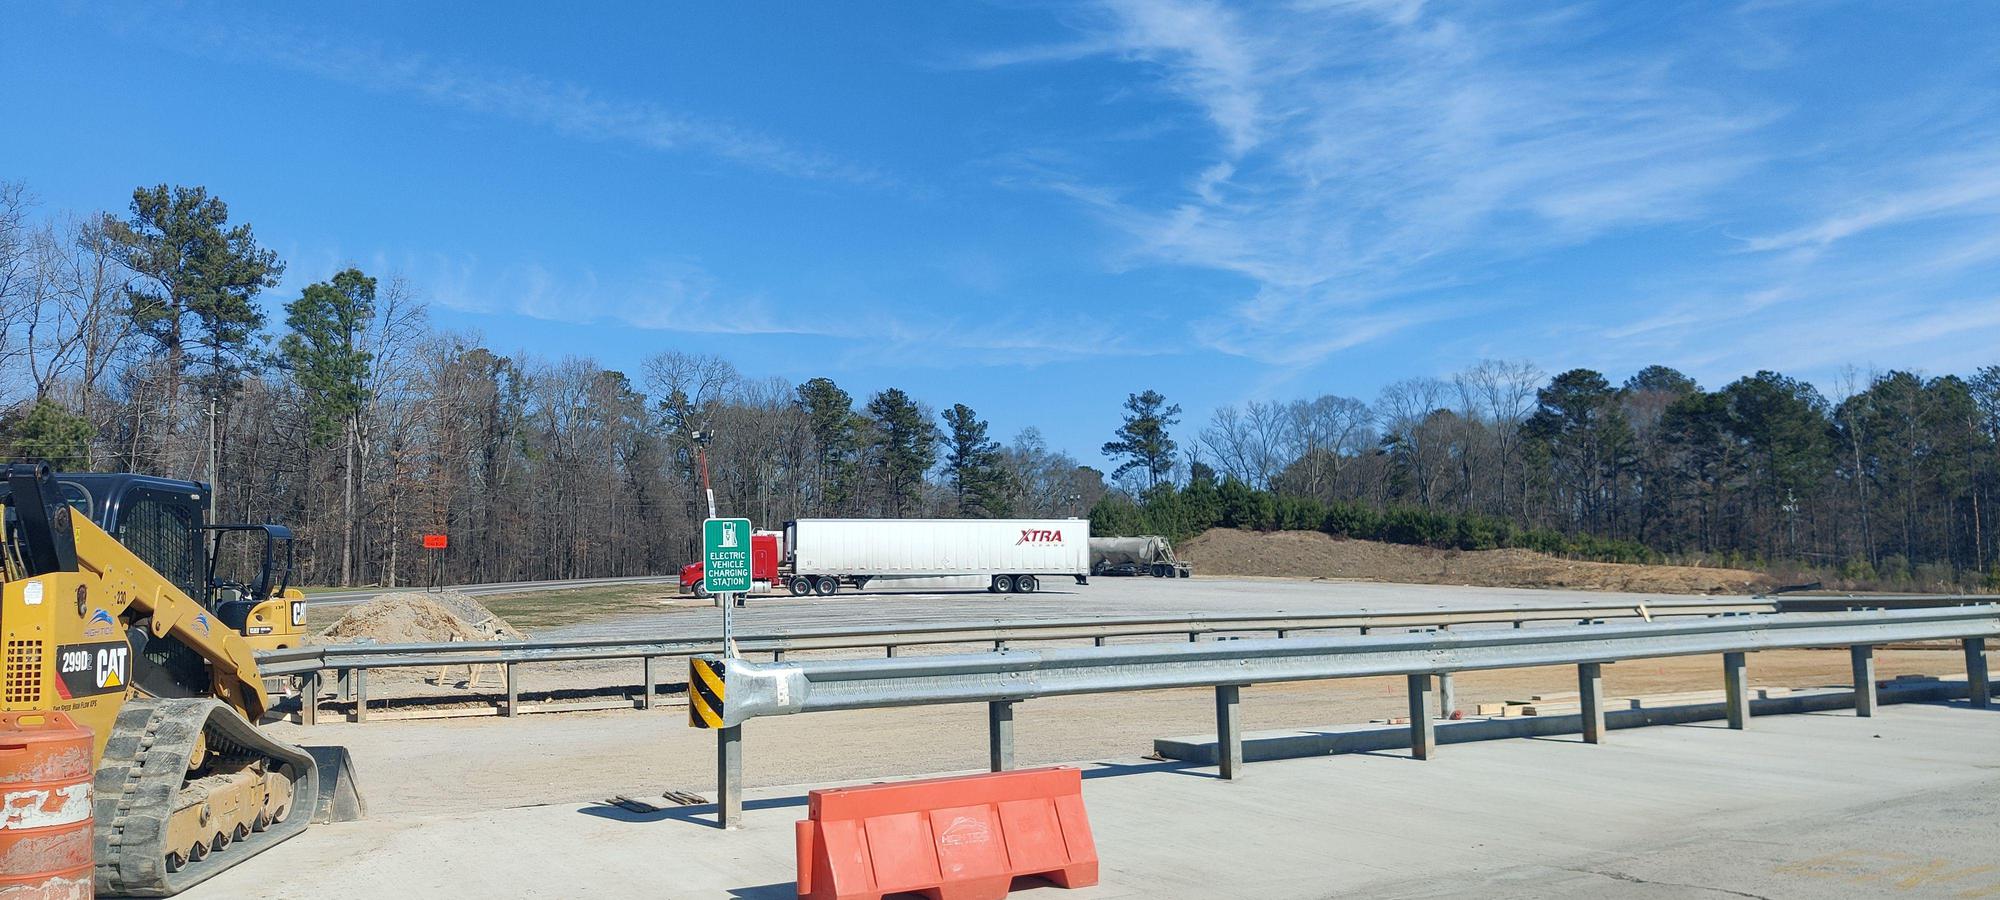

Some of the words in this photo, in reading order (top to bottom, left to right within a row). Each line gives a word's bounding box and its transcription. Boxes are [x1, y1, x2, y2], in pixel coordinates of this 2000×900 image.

[1015, 528, 1062, 546] XTRA
[710, 551, 746, 560] ELECTRIC
[712, 560, 744, 568] VEHICLE
[708, 569, 748, 577] CHARGING
[712, 577, 744, 586] STATION
[292, 602, 306, 625] CA
[96, 647, 127, 689] CAT
